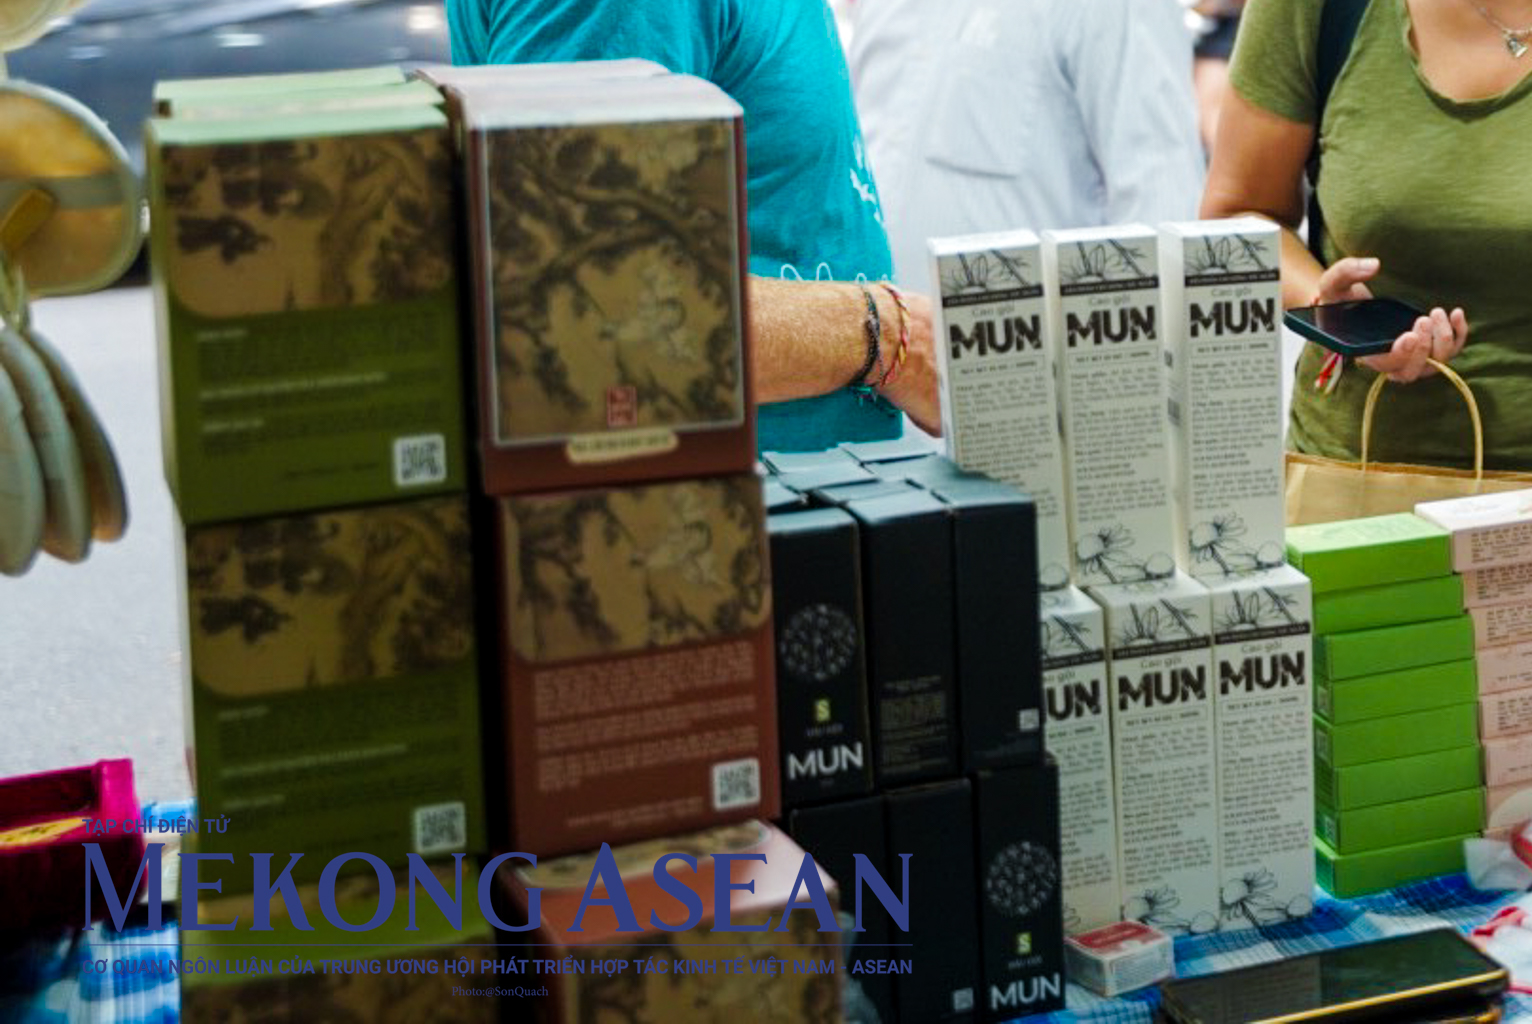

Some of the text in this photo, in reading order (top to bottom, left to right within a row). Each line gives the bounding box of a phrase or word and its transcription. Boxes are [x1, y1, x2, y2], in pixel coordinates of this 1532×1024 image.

[950, 313, 1043, 360] MUN
[1066, 305, 1157, 348] MUN
[1190, 297, 1275, 338] MUN
[1118, 665, 1206, 712] MUN
[1220, 650, 1305, 695] MUN
[1046, 679, 1102, 721] UN
[788, 741, 864, 780] MUN
[990, 972, 1061, 1011] MUN
